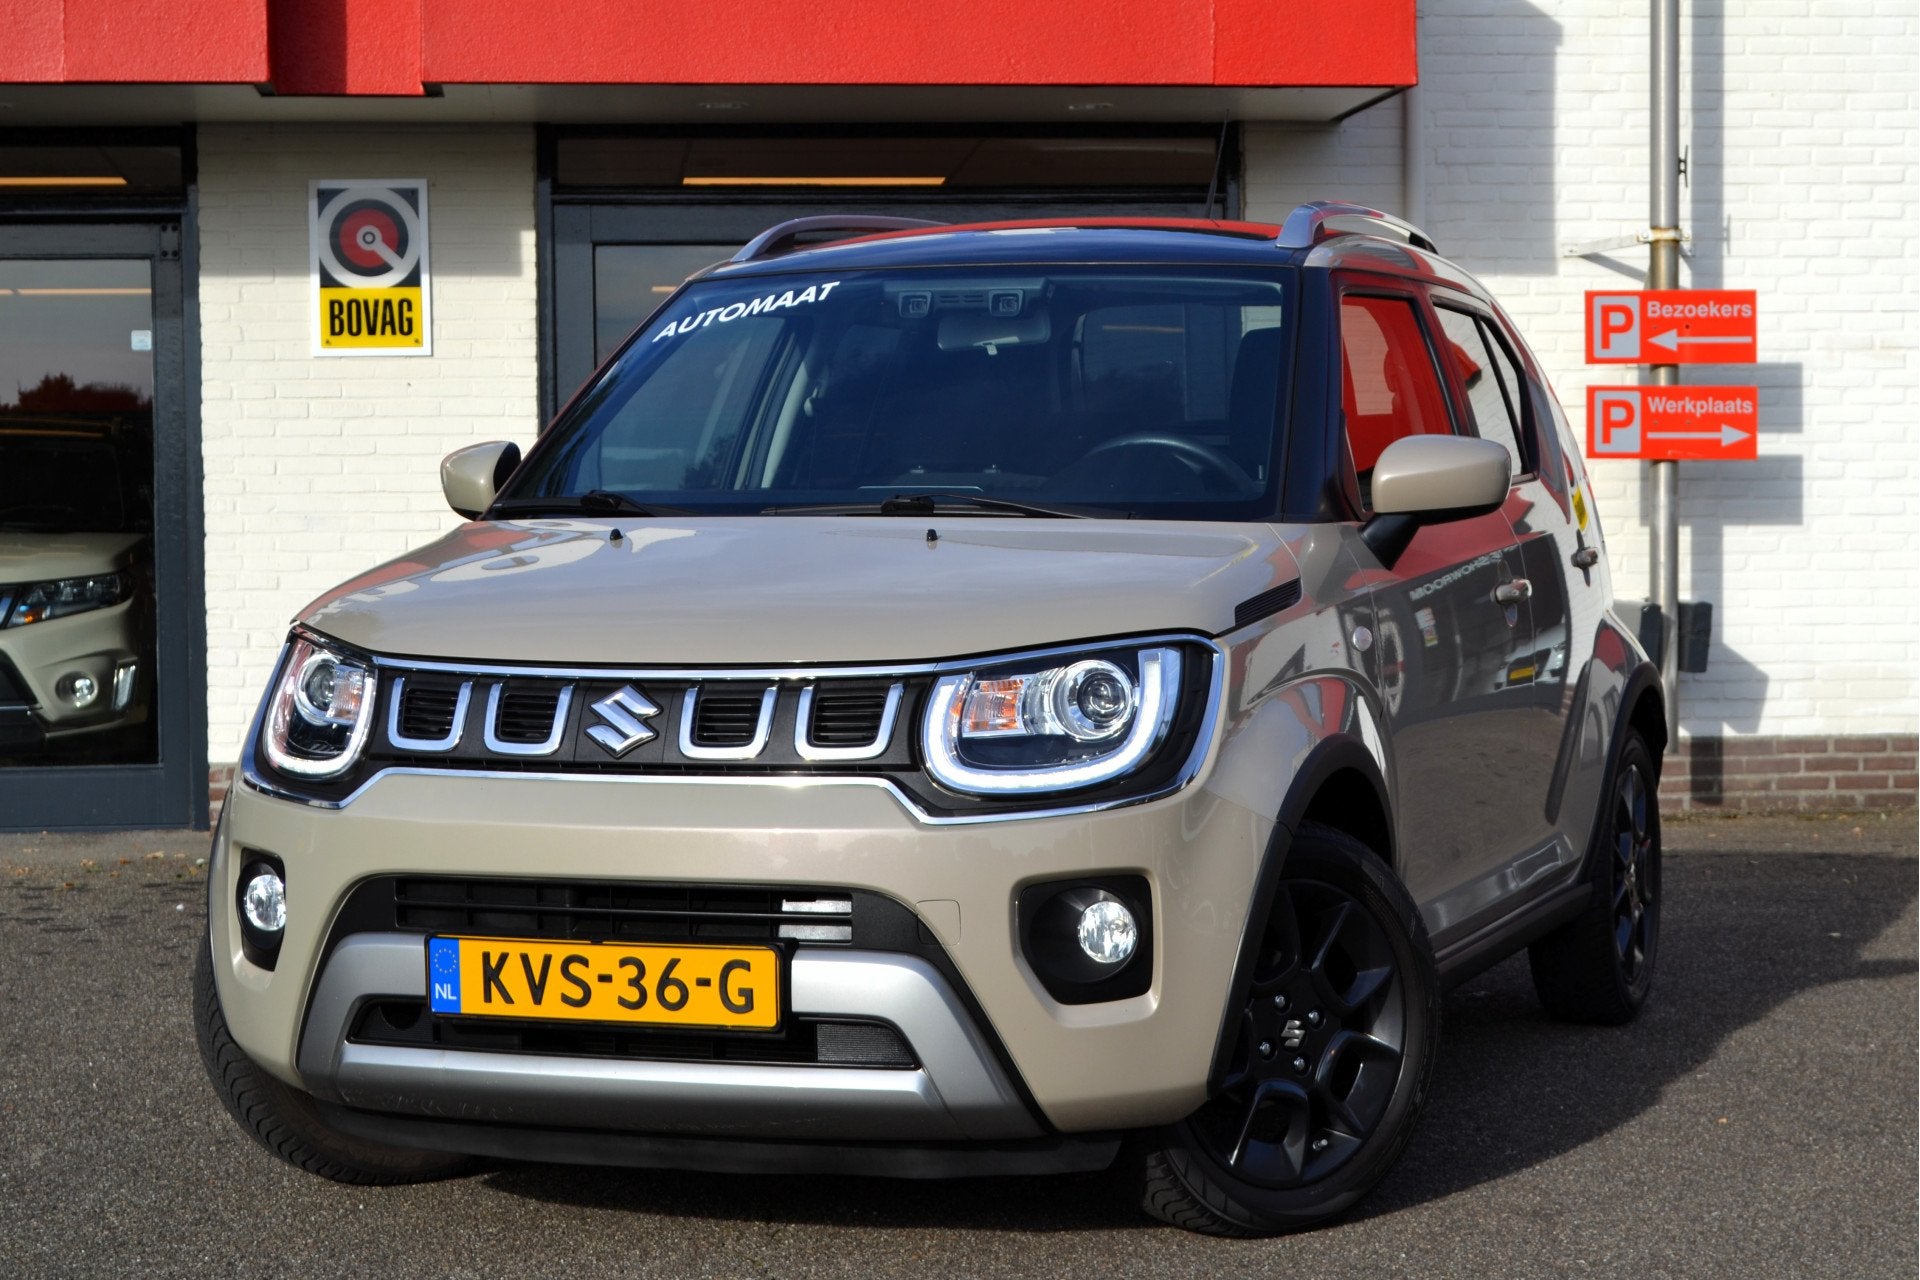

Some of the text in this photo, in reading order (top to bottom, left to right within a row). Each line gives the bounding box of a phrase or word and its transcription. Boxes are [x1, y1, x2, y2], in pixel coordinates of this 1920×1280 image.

[329, 298, 413, 336] BOVAG
[652, 281, 840, 343] AUTOMAAT
[1601, 304, 1634, 349] P
[1647, 301, 1752, 317] Bezoekers
[1602, 400, 1635, 444] P
[1648, 397, 1753, 417] Werkplaats
[434, 983, 457, 1000] NL
[482, 951, 754, 1014] KVS-36-G
